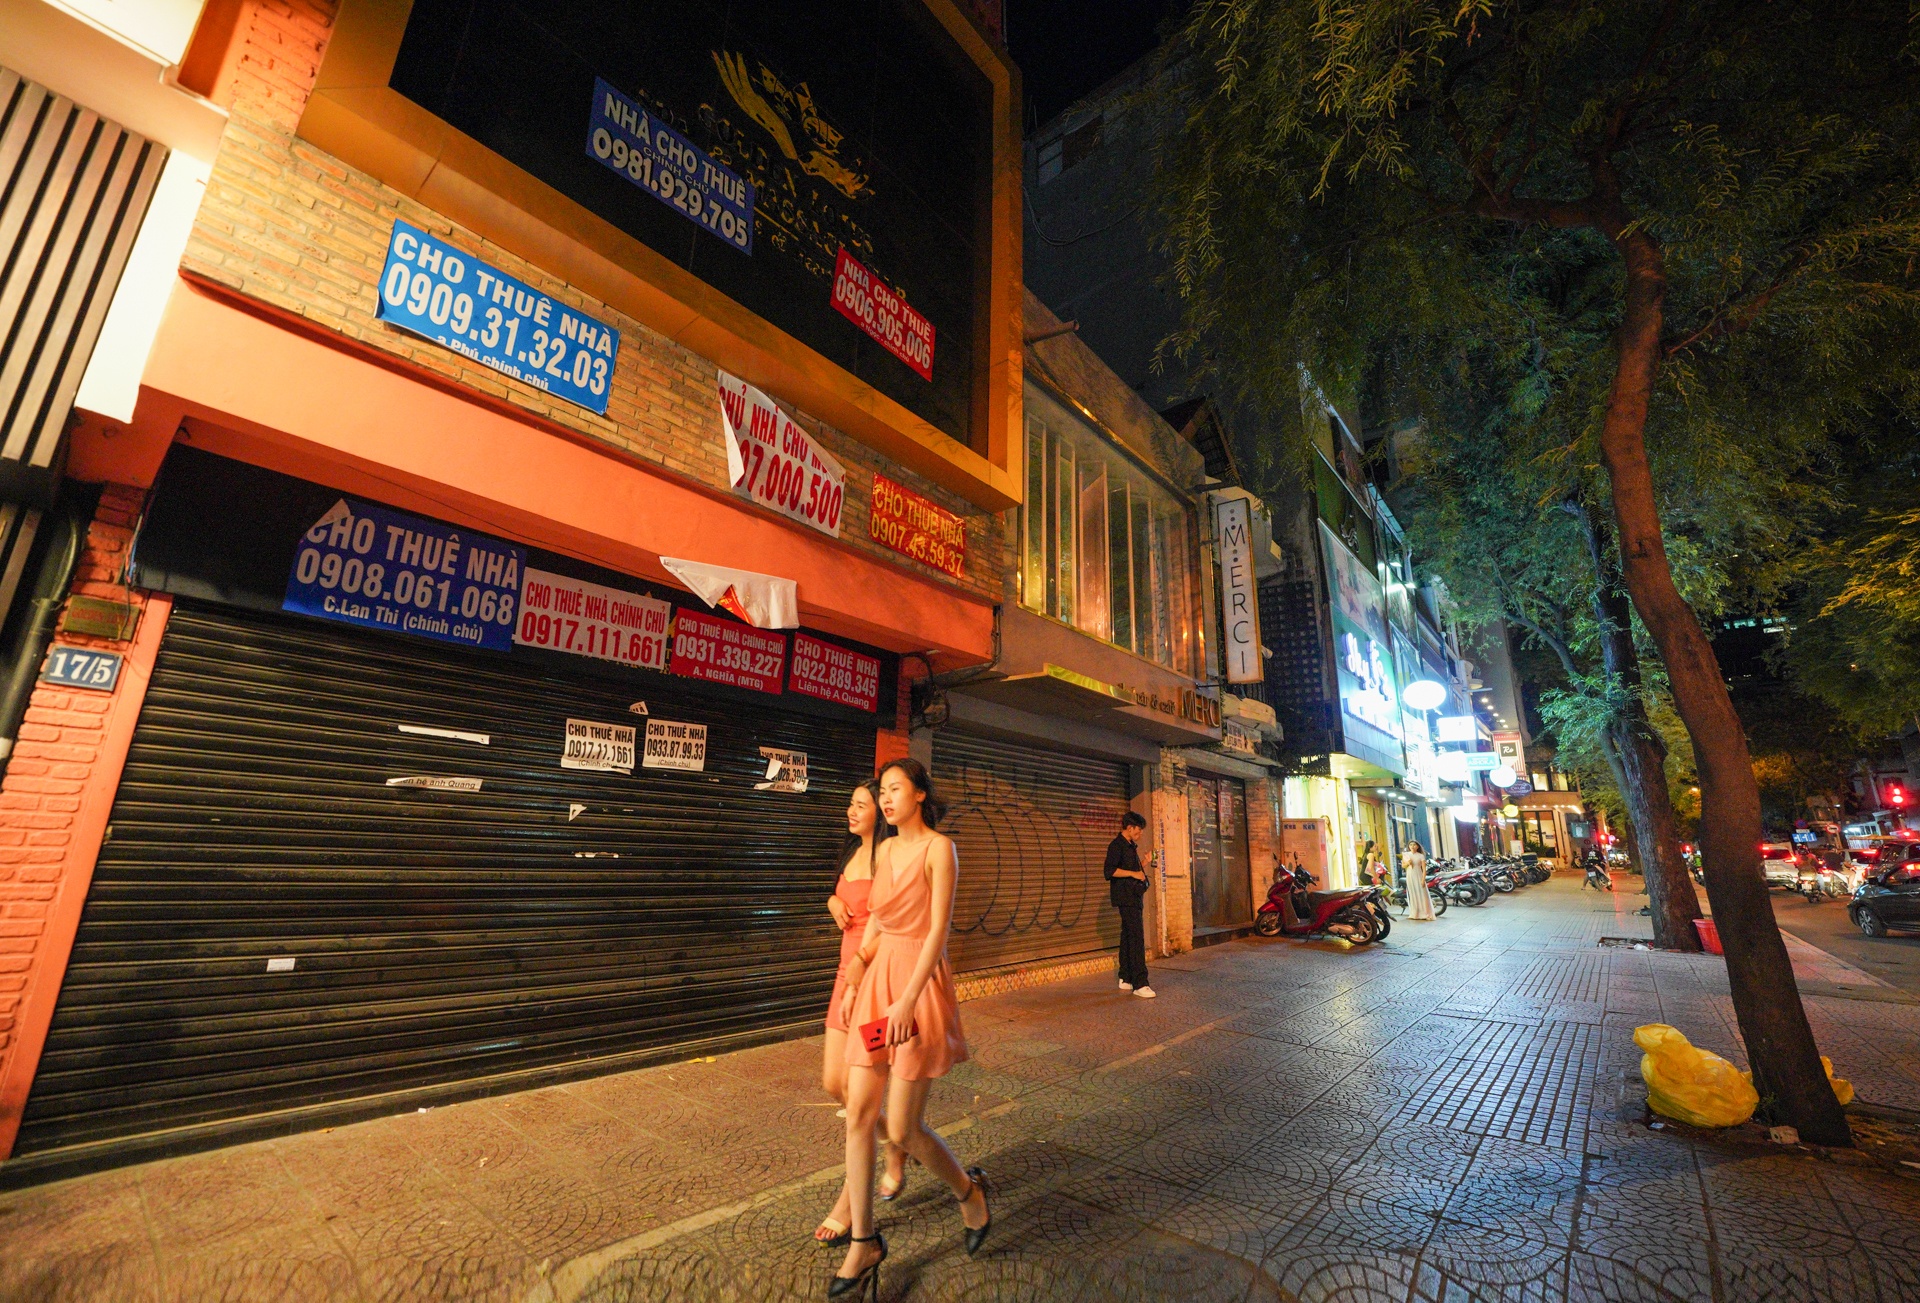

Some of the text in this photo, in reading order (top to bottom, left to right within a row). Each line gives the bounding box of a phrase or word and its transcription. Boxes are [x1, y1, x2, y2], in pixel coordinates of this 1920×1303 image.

[604, 93, 651, 146] NHÀ
[656, 131, 697, 174] CHO
[702, 159, 746, 208] THUÊ
[643, 147, 682, 177] CHÍNH
[592, 127, 749, 248] 0981.929.705
[393, 232, 612, 358] CHO THUÊ NHÀ
[843, 258, 870, 293] NHÀ
[874, 284, 899, 315] CHO
[902, 305, 931, 343] THUÊ
[384, 262, 609, 396] 0909.31.32.03
[835, 274, 931, 369] 0906.905.006
[450, 338, 480, 361] Phú
[482, 355, 522, 379] chính
[524, 373, 549, 391] chủ
[750, 403, 779, 448] NHÀ
[874, 483, 903, 518] CHO
[906, 499, 939, 536] THUÊ
[306, 515, 519, 591] CHO THUÊ NHÀ
[871, 513, 964, 578] 0907.43.59.37
[296, 547, 514, 626] 0908.061.068
[525, 581, 667, 634] CHO THUÊ NHÀ CHÍNH CHỦ
[1224, 523, 1250, 674] MERCI
[323, 595, 483, 644] C.Lan Thi (chính chủ)
[521, 611, 663, 666] 0917.111.661
[678, 616, 783, 655] CHO THUÊ NHÀ CHÍNH CHỦ
[49, 652, 115, 684] 17/5
[675, 634, 783, 678] 0931.339.227
[692, 665, 764, 691] A. NGHĨA (MTG)
[793, 655, 877, 698] 0922.889.345
[795, 638, 878, 678] CHO THUÊ NHÀ
[797, 679, 870, 710] Liên hệ A Quang
[568, 723, 633, 744] CHO THUÊ NHÀ
[646, 738, 704, 761] 0933.87.99.33
[648, 723, 705, 741] CHO THUÊ NHÀ
[448, 780, 476, 789] Quang
